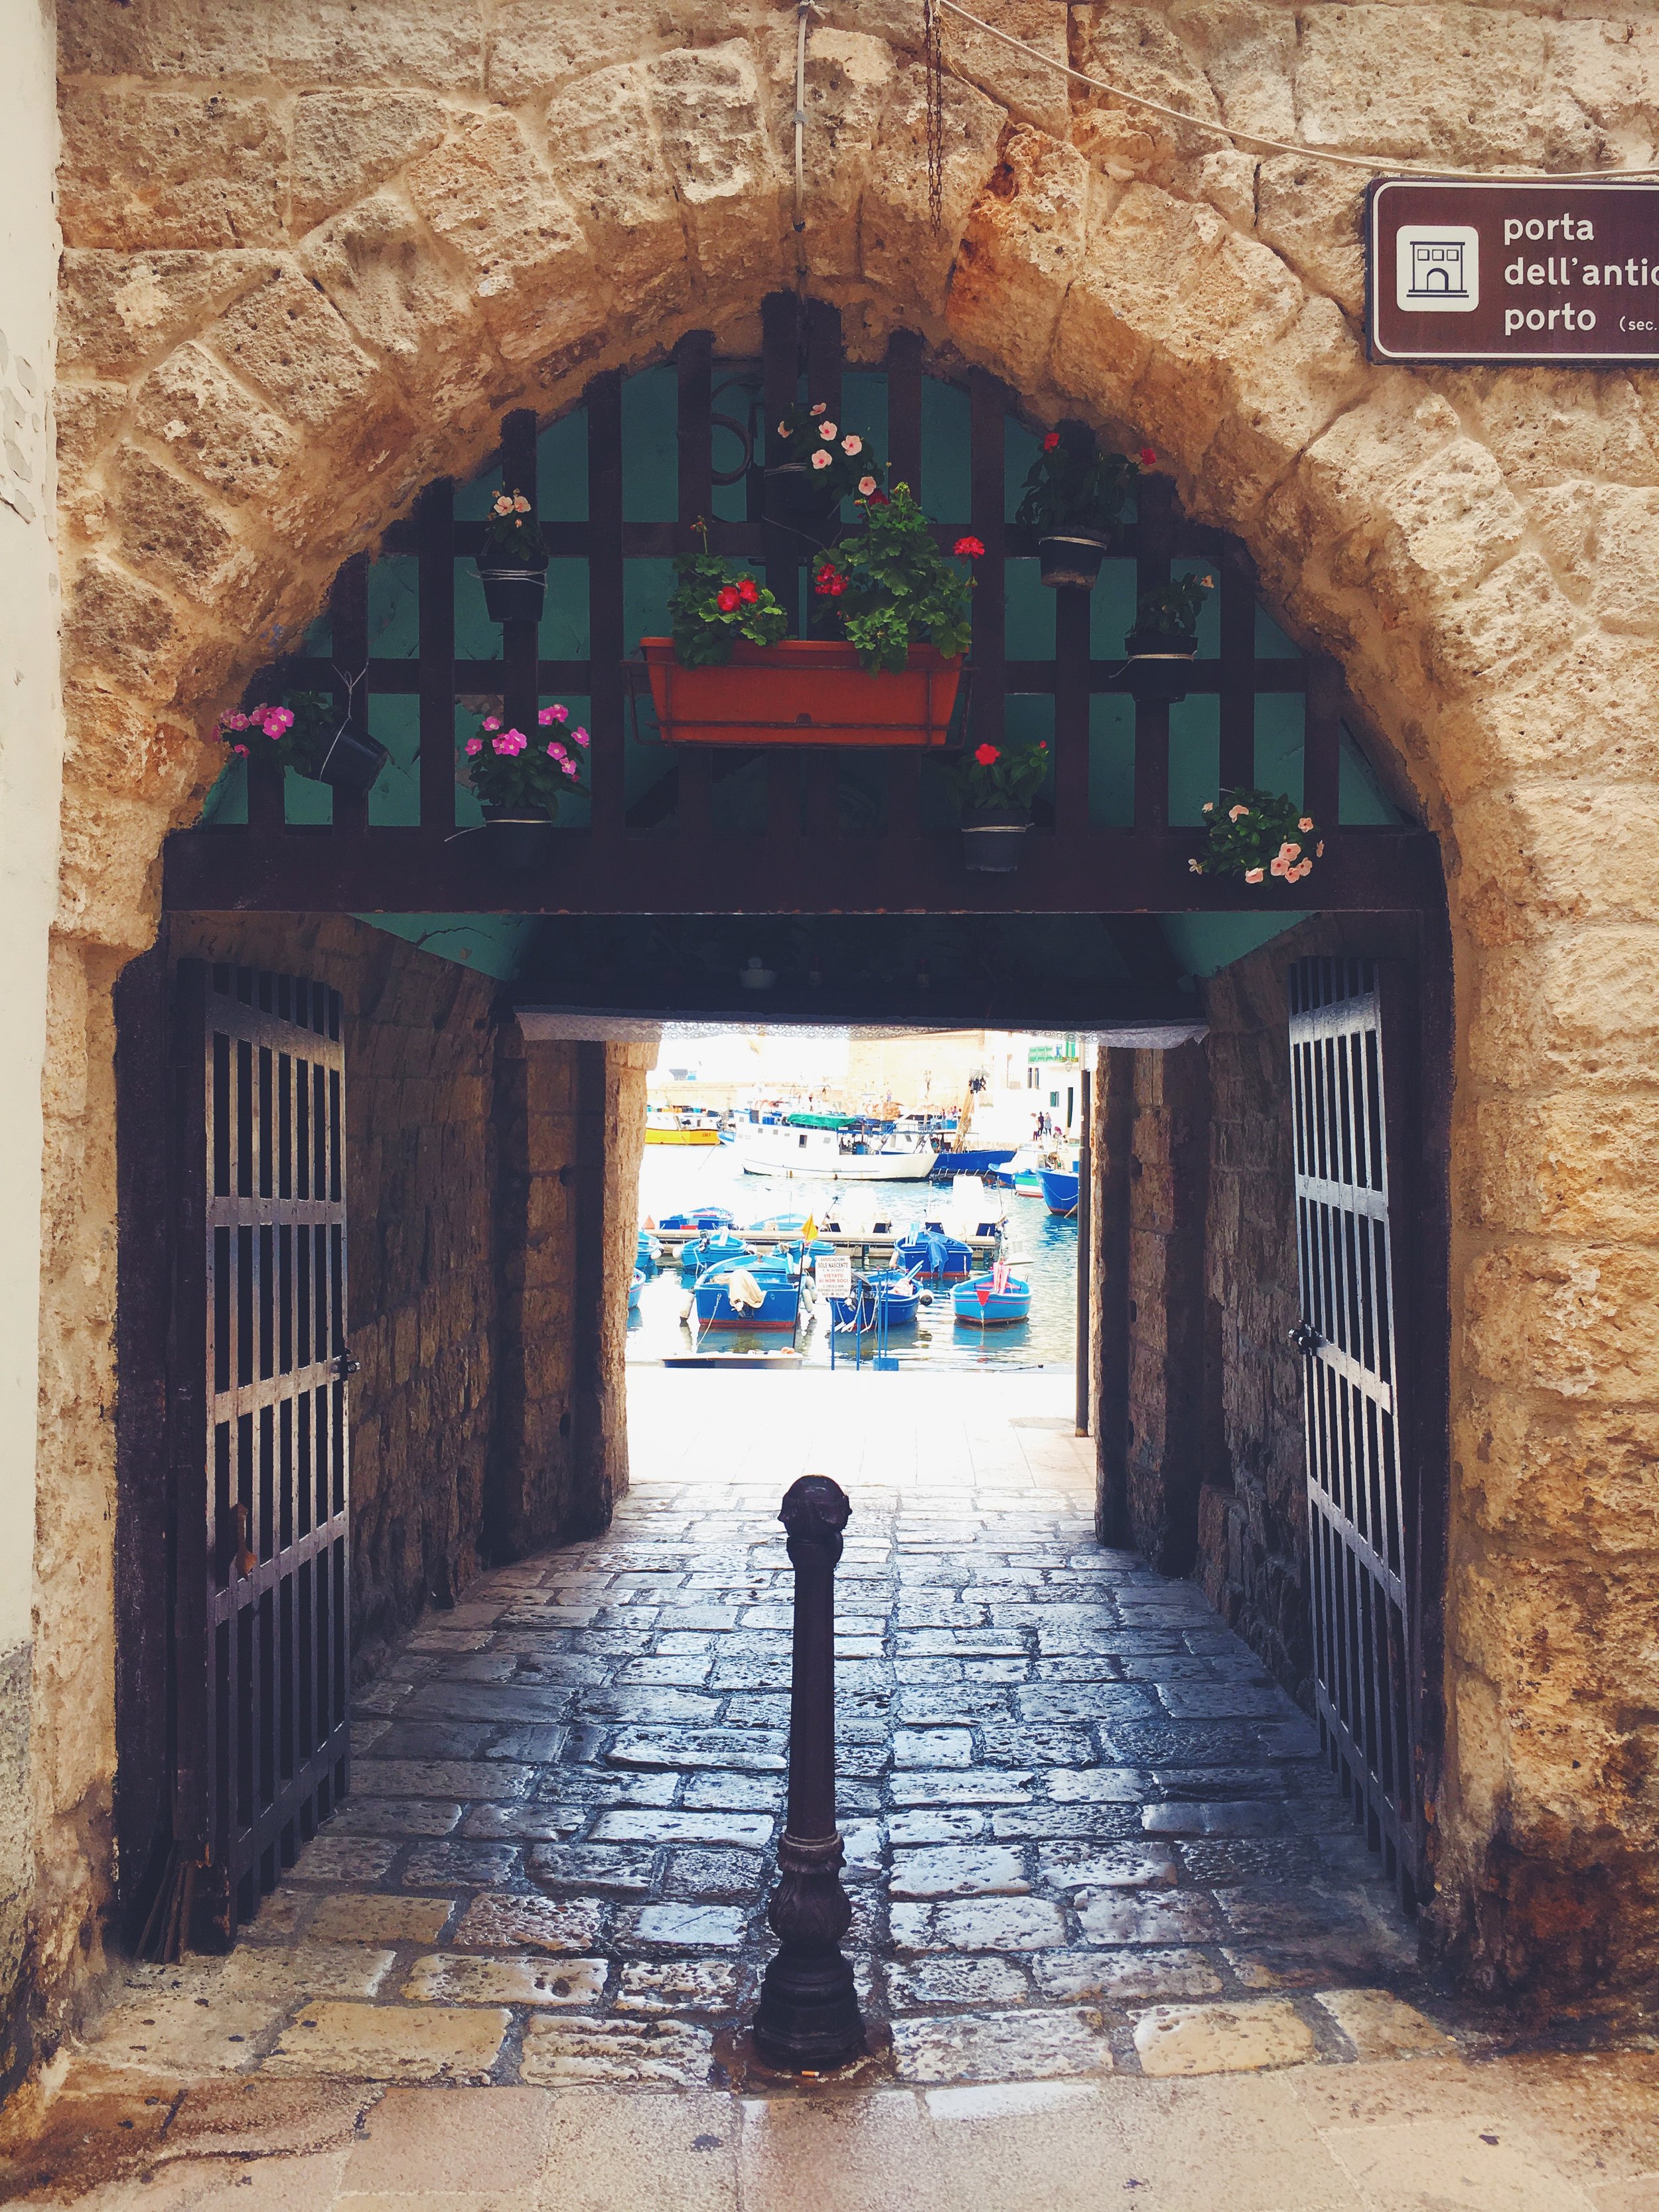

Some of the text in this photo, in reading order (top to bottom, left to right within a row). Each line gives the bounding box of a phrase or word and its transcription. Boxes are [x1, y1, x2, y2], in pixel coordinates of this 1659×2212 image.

[1504, 212, 1594, 246] porta
[1505, 302, 1657, 336] porto (sec.
